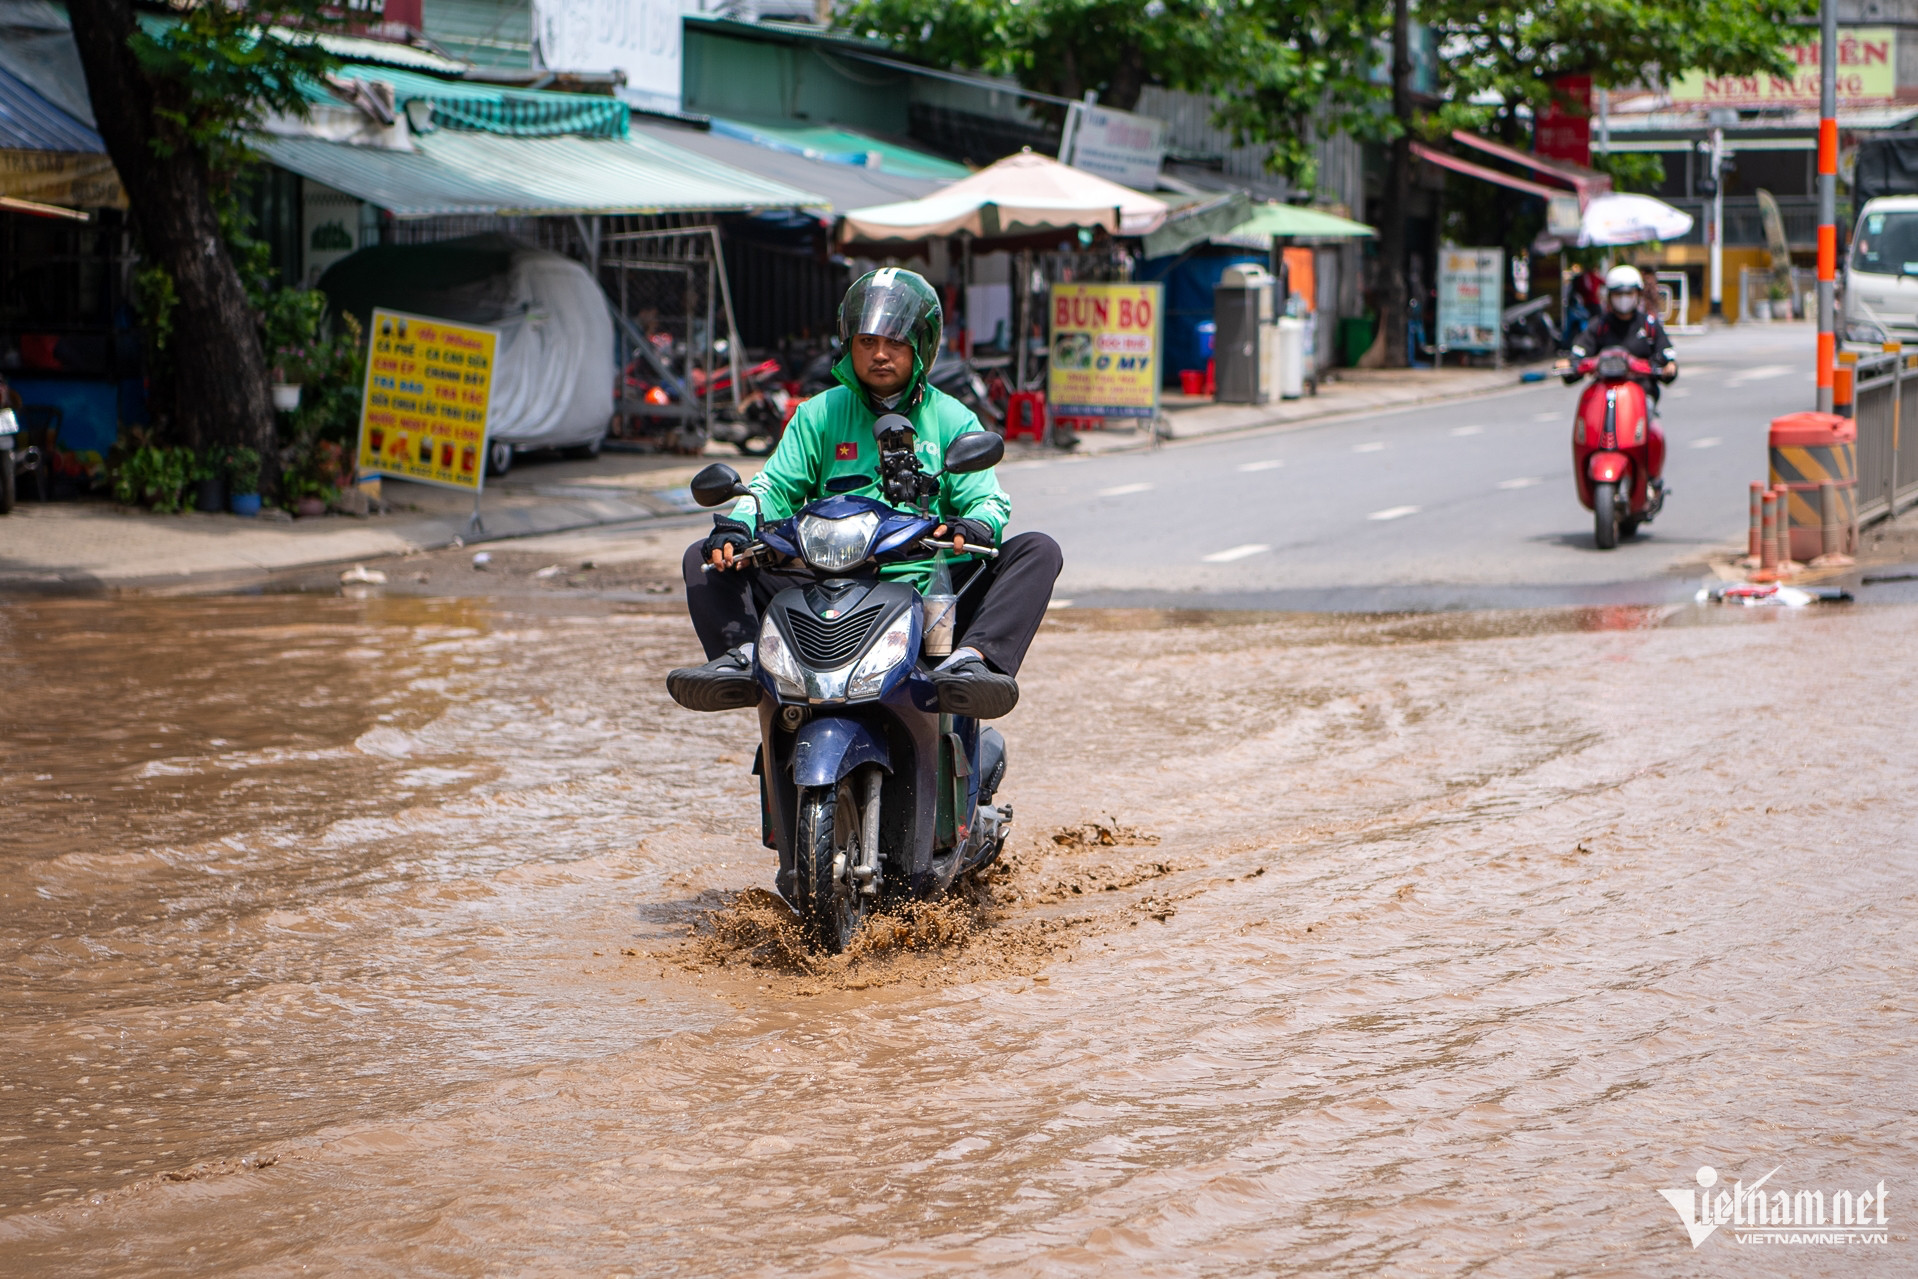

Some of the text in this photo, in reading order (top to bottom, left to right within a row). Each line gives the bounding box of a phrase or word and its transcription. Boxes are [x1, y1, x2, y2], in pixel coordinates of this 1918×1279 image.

[1054, 287, 1152, 330] BÚN BÒ
[913, 437, 941, 457] Gra
